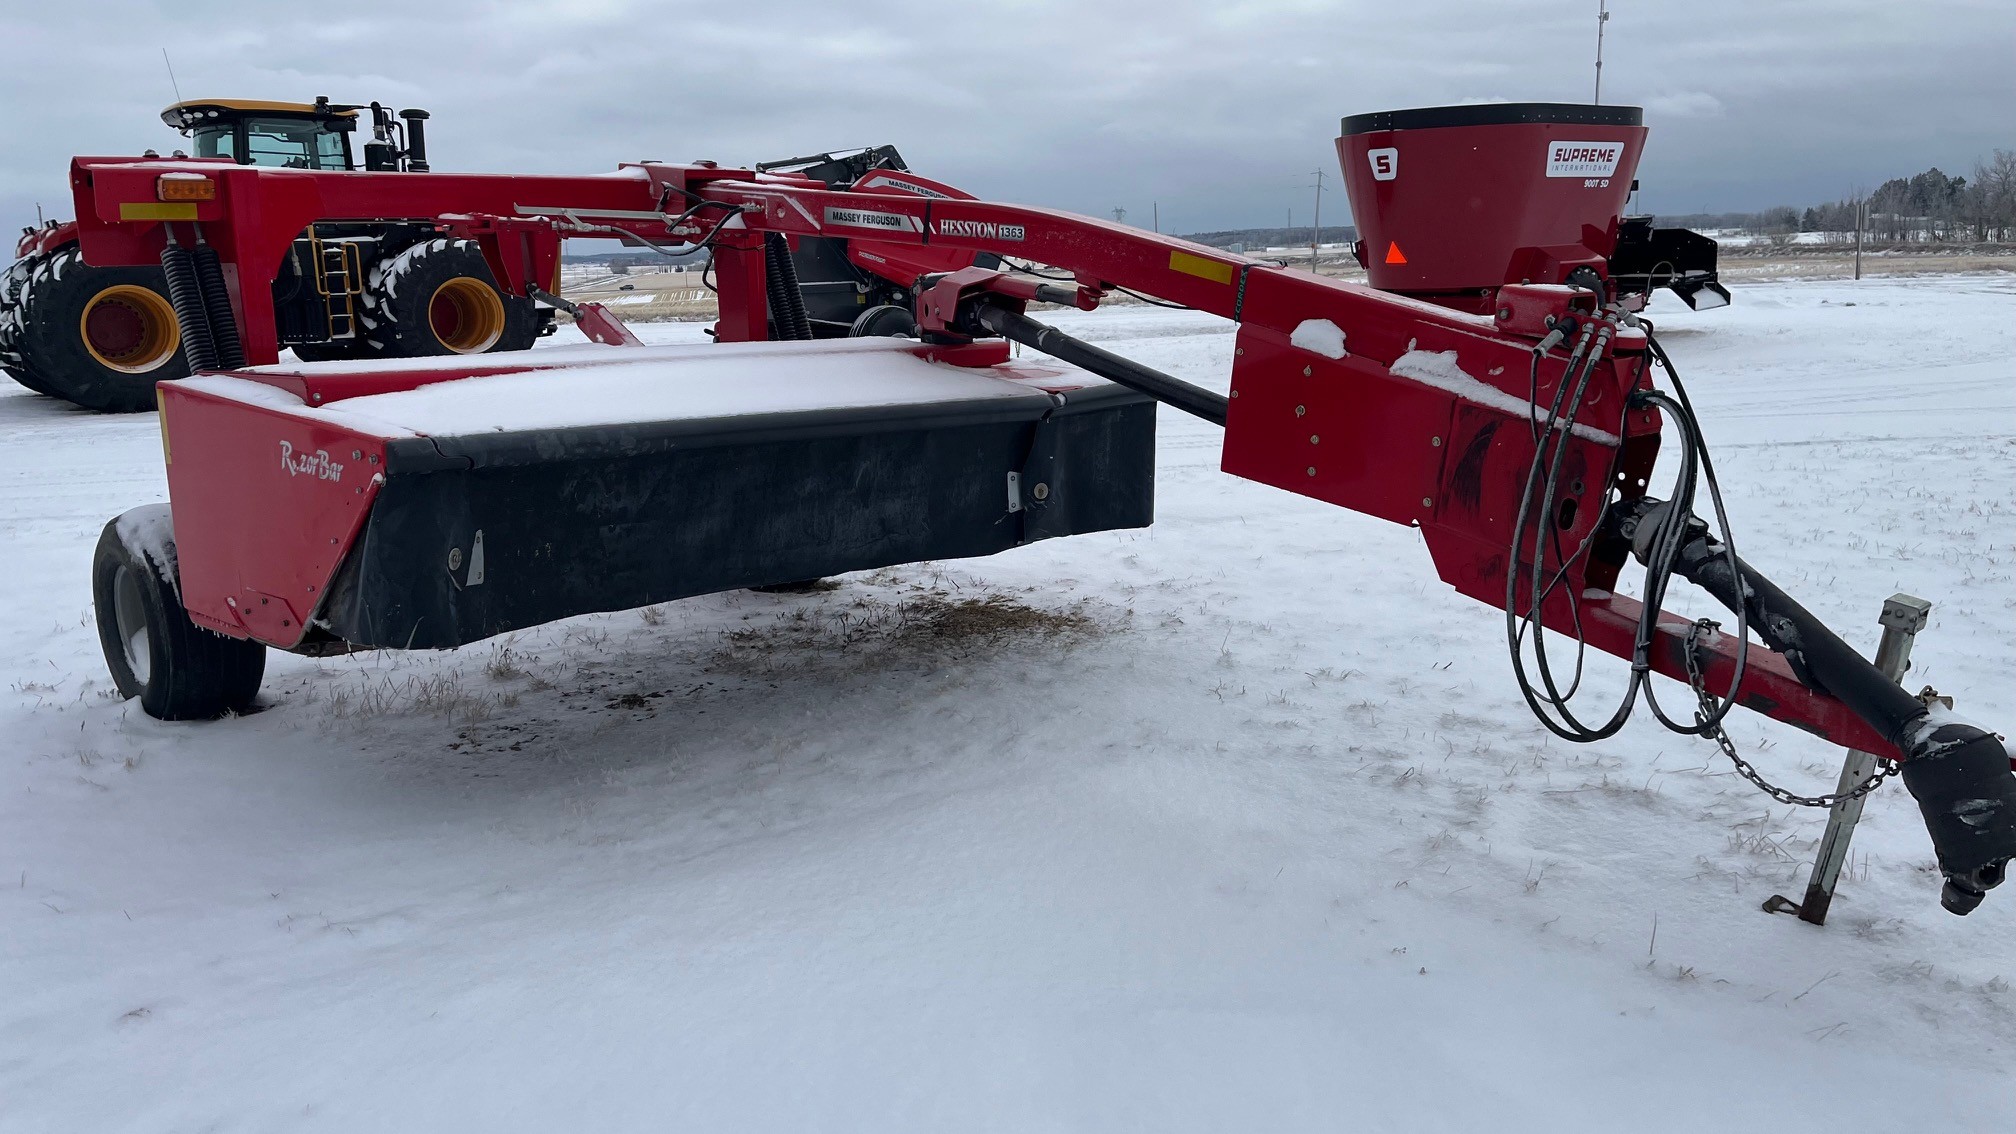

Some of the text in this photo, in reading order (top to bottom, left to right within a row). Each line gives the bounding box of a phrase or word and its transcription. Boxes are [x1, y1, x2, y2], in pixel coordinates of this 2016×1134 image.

[1554, 148, 1615, 162] SUPREME
[1376, 155, 1391, 174] S
[1551, 164, 1612, 172] INTERNATIONAL
[888, 180, 916, 191] MASSEY
[1584, 179, 1609, 188] 900T SD
[832, 211, 901, 227] MASSEY FERGUSON
[940, 219, 1023, 239] HESSTON 1363
